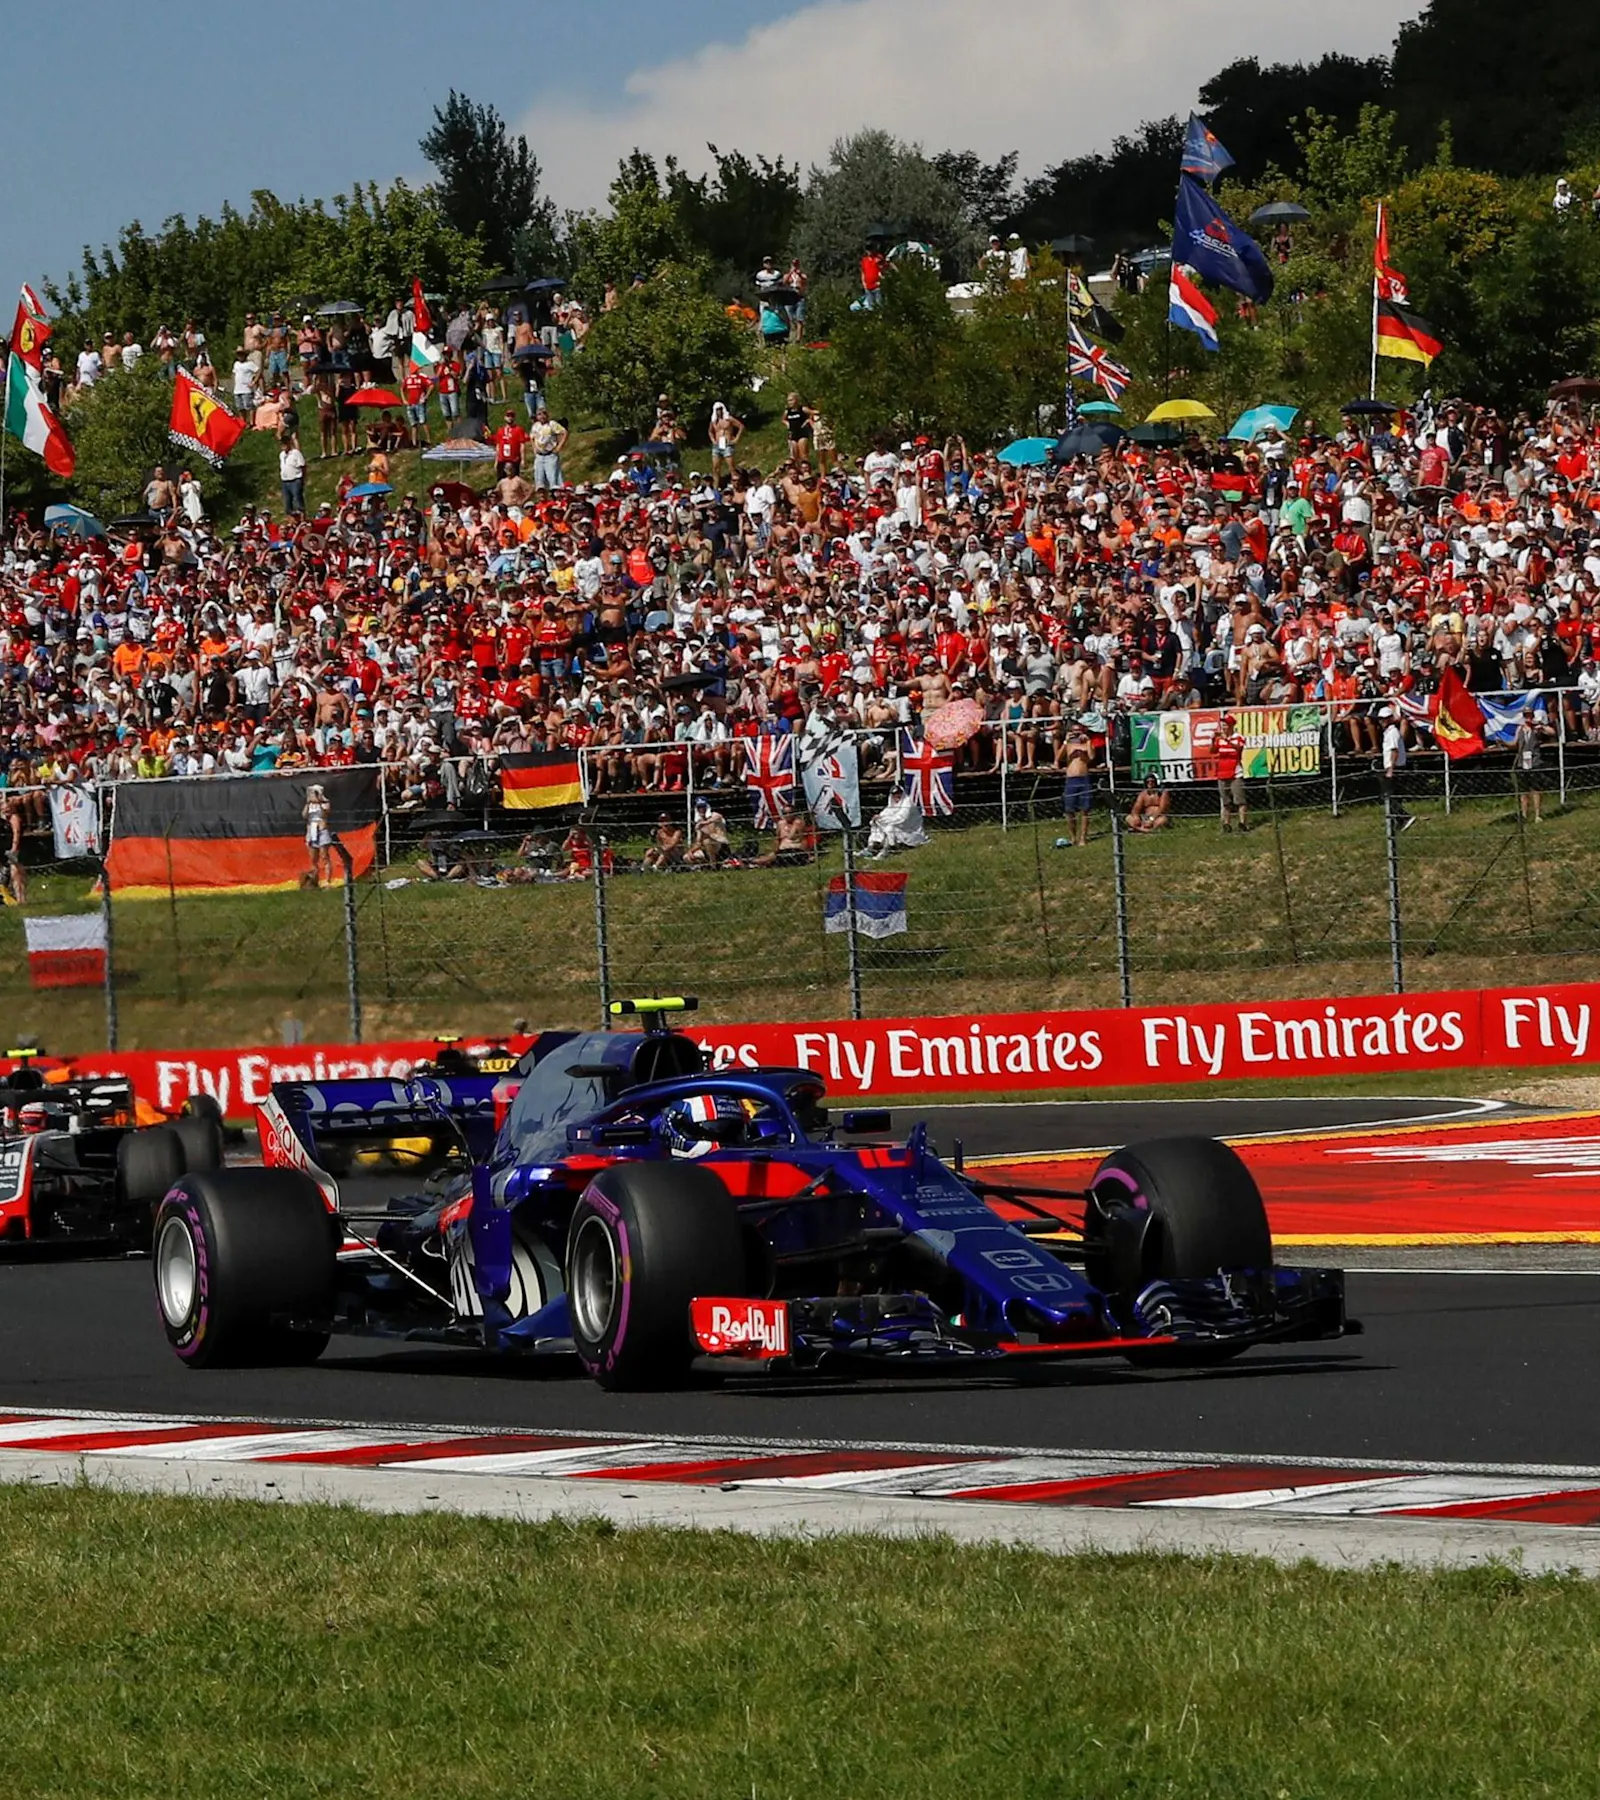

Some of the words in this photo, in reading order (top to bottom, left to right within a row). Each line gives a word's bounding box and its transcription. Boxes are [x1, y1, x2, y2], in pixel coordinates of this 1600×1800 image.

[794, 1032, 875, 1090] Fly
[887, 1023, 1103, 1078] Emirates
[1141, 1016, 1225, 1075] Fly
[1237, 1006, 1464, 1062] Emirates
[1500, 996, 1590, 1057] Fly
[155, 1060, 230, 1115] Fly
